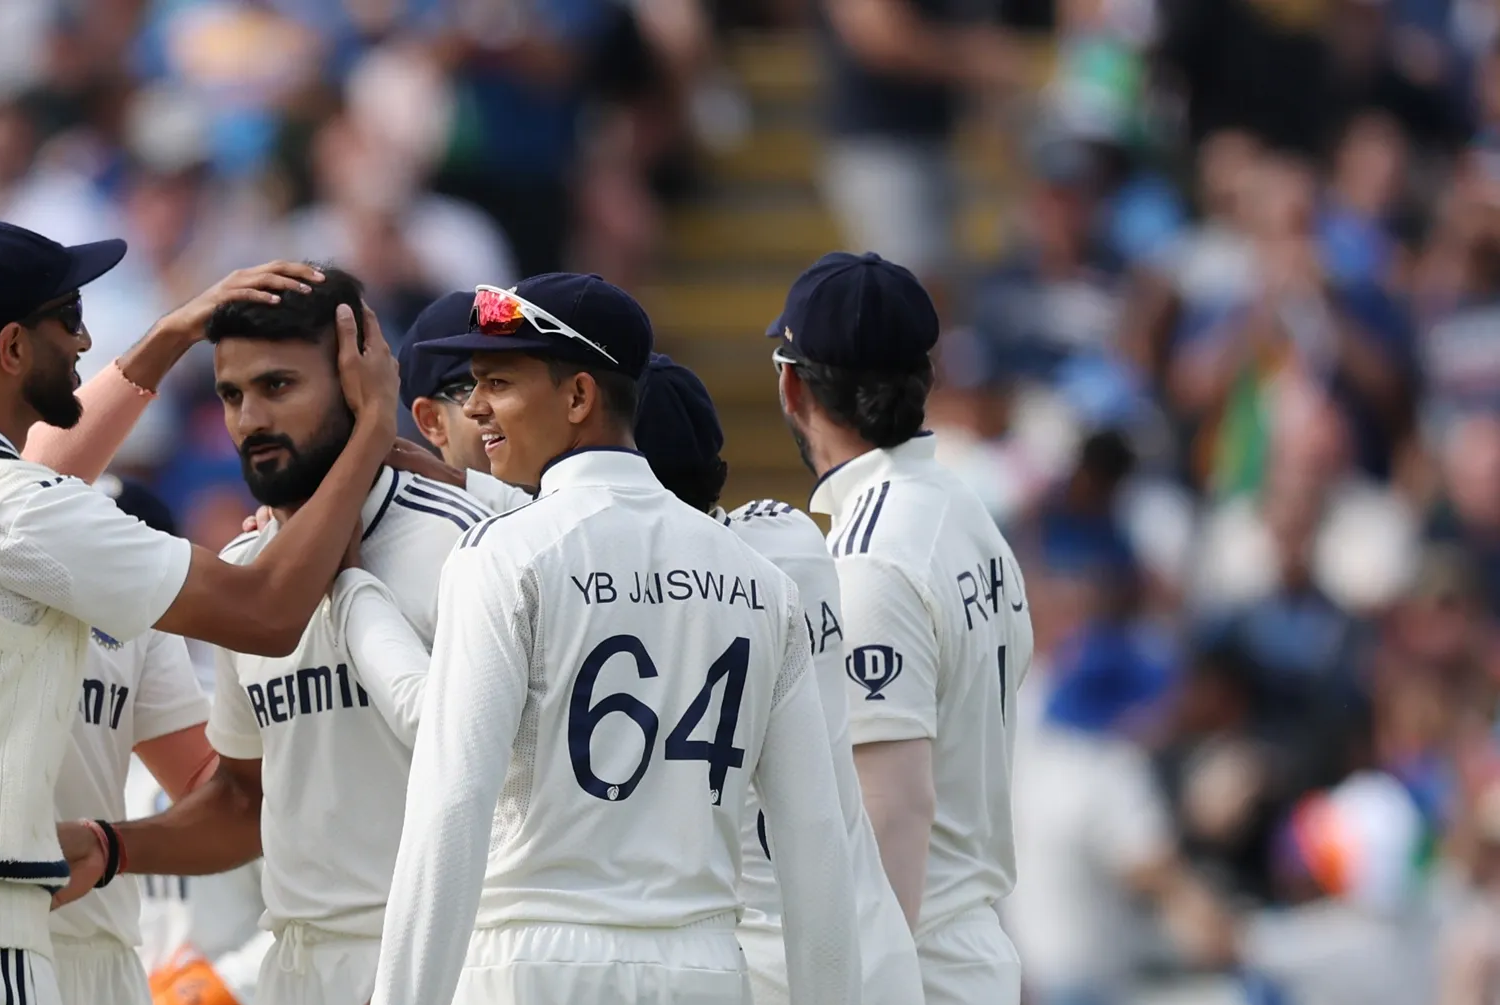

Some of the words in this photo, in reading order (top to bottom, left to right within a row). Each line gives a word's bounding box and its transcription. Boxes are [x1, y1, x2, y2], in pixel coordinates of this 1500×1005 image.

[571, 571, 617, 605] YB
[629, 569, 764, 610] JAISWAL
[568, 634, 750, 806] 64
